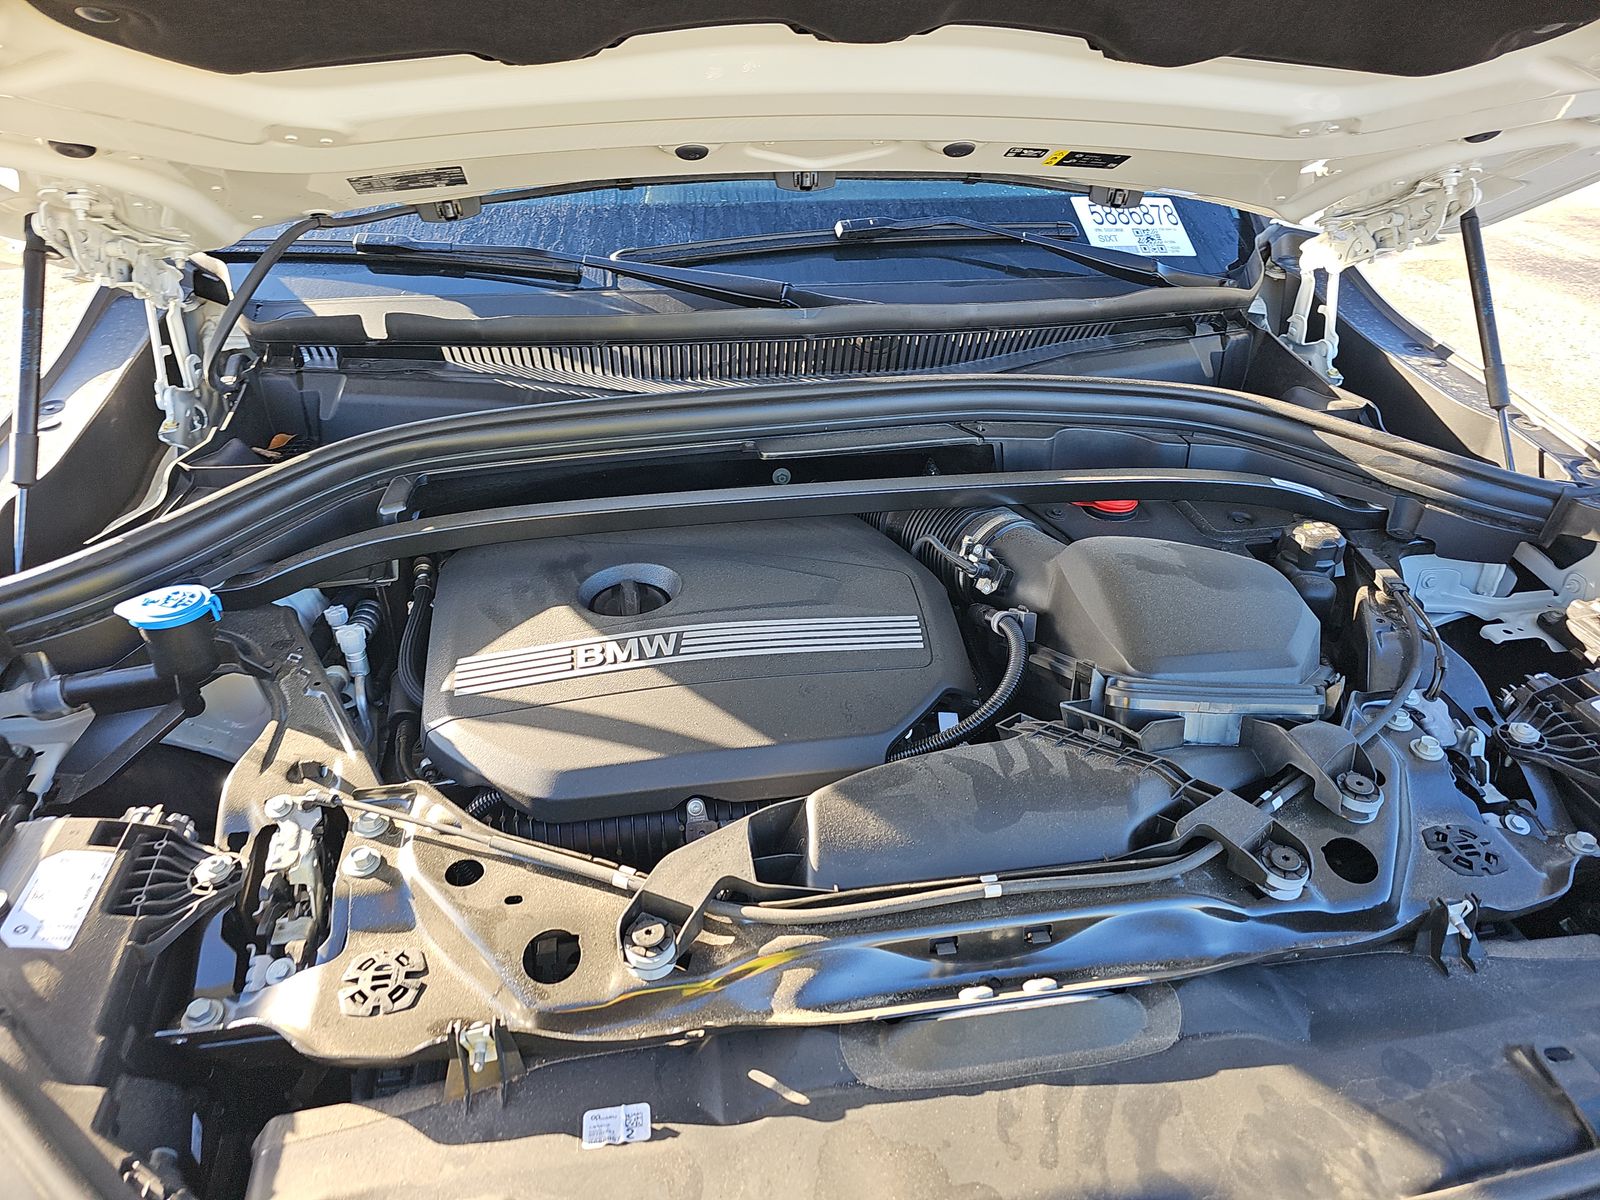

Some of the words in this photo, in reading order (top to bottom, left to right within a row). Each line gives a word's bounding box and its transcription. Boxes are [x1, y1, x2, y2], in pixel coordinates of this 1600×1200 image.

[1088, 204, 1178, 225] 5886878
[1098, 234, 1119, 243] SIXT
[575, 632, 678, 669] BMW
[626, 1127, 635, 1140] 2
